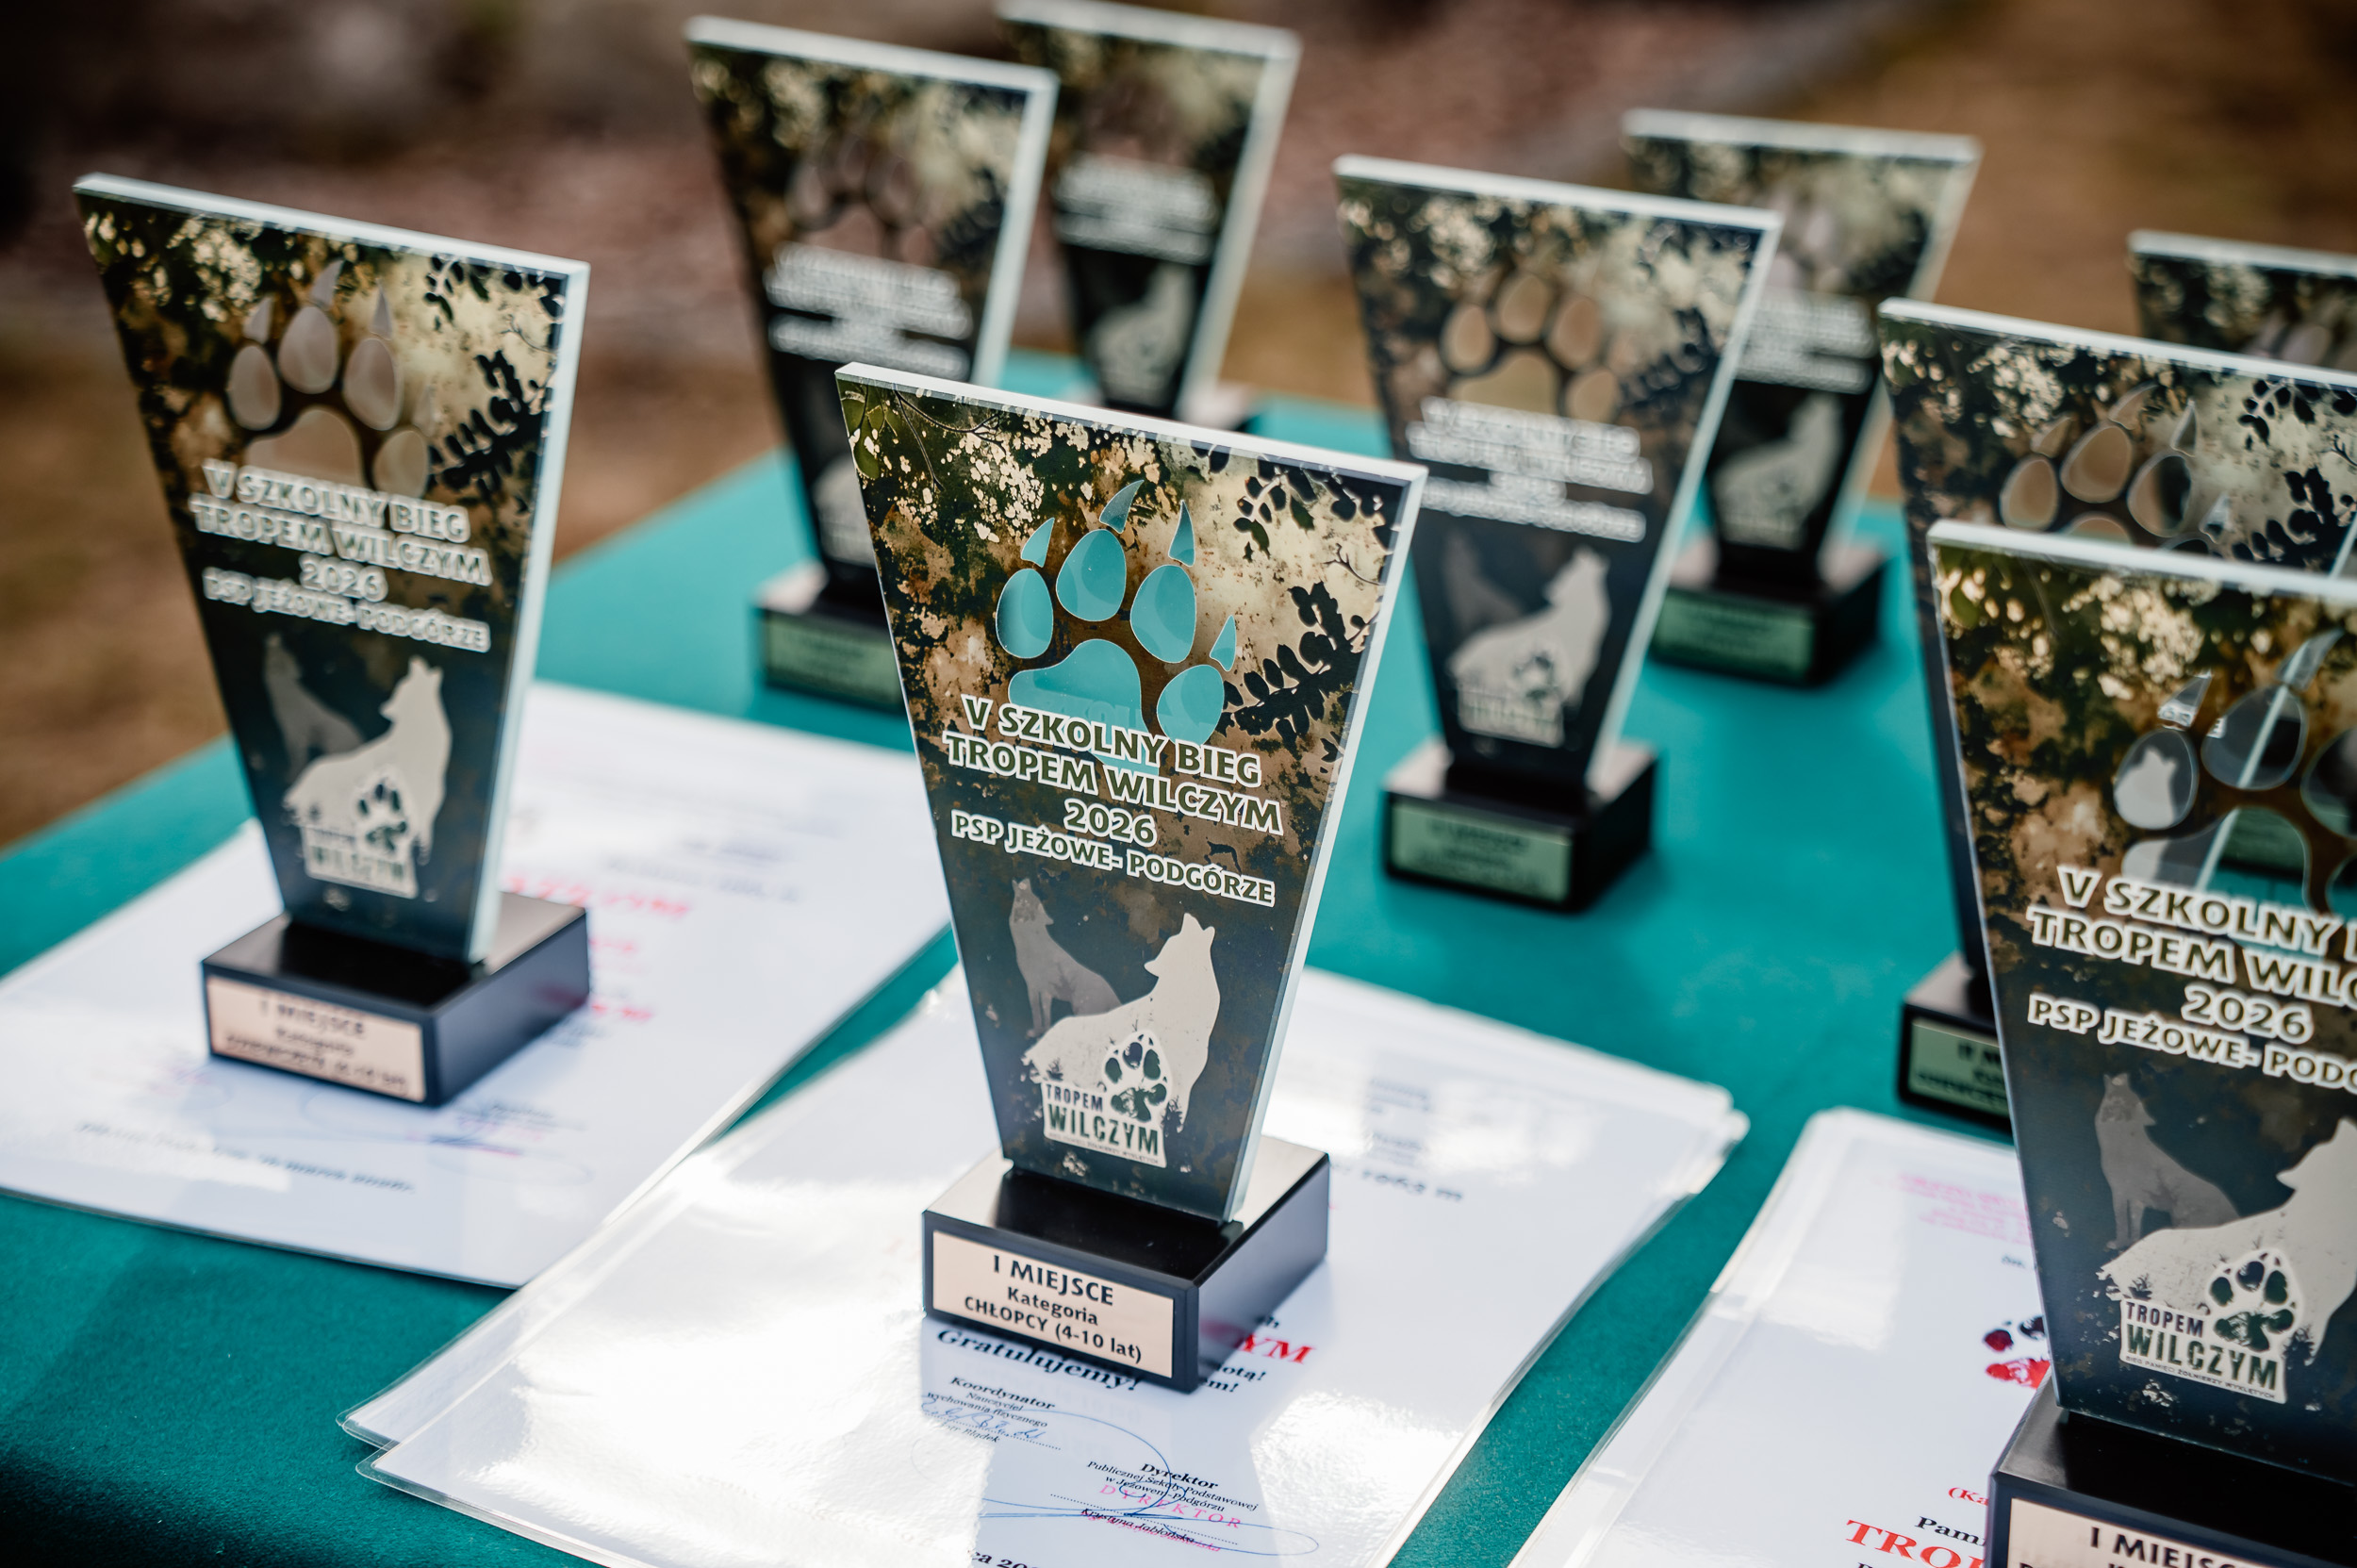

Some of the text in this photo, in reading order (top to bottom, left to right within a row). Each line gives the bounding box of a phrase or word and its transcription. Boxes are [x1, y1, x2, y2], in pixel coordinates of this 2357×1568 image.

[388, 495, 470, 543] BIEG
[299, 553, 388, 602] 2026
[961, 694, 1261, 788] V SZKOLNY BIEG
[944, 733, 1284, 835] TROPEM WILCZYM
[1063, 798, 1157, 847] 2026
[951, 811, 1003, 846] PSP
[1127, 854, 1277, 908] PODGÓRZE
[2057, 864, 2102, 908] V
[2103, 876, 2343, 955] SZKOLNY
[2026, 905, 2236, 984] TROPEM
[2028, 993, 2101, 1034] PSP
[2182, 983, 2314, 1044] 2026
[1046, 1083, 1103, 1113] TROPEM
[1047, 1103, 1159, 1156] WILCZYM
[992, 1255, 1114, 1307] I MIEJSCE
[964, 1296, 1142, 1364] CHŁOPCY (4-10 lat)
[1007, 1286, 1098, 1327] Kategoria
[2126, 1301, 2203, 1338] TROPEM
[937, 1329, 1143, 1391] Gratulujemy!
[2127, 1323, 2277, 1392] WILCZYM
[928, 1392, 990, 1413] wychowania
[992, 1409, 1048, 1428] fizycznego
[950, 1377, 1056, 1410] Koordynator
[965, 1393, 1024, 1411] Nauczyciel
[1087, 1461, 1144, 1483] Publicznej
[1184, 1486, 1260, 1511] Podstawowej
[1140, 1463, 1219, 1490] Dyrektor
[1081, 1508, 1133, 1528] Krystyna
[2090, 1527, 2100, 1548] I
